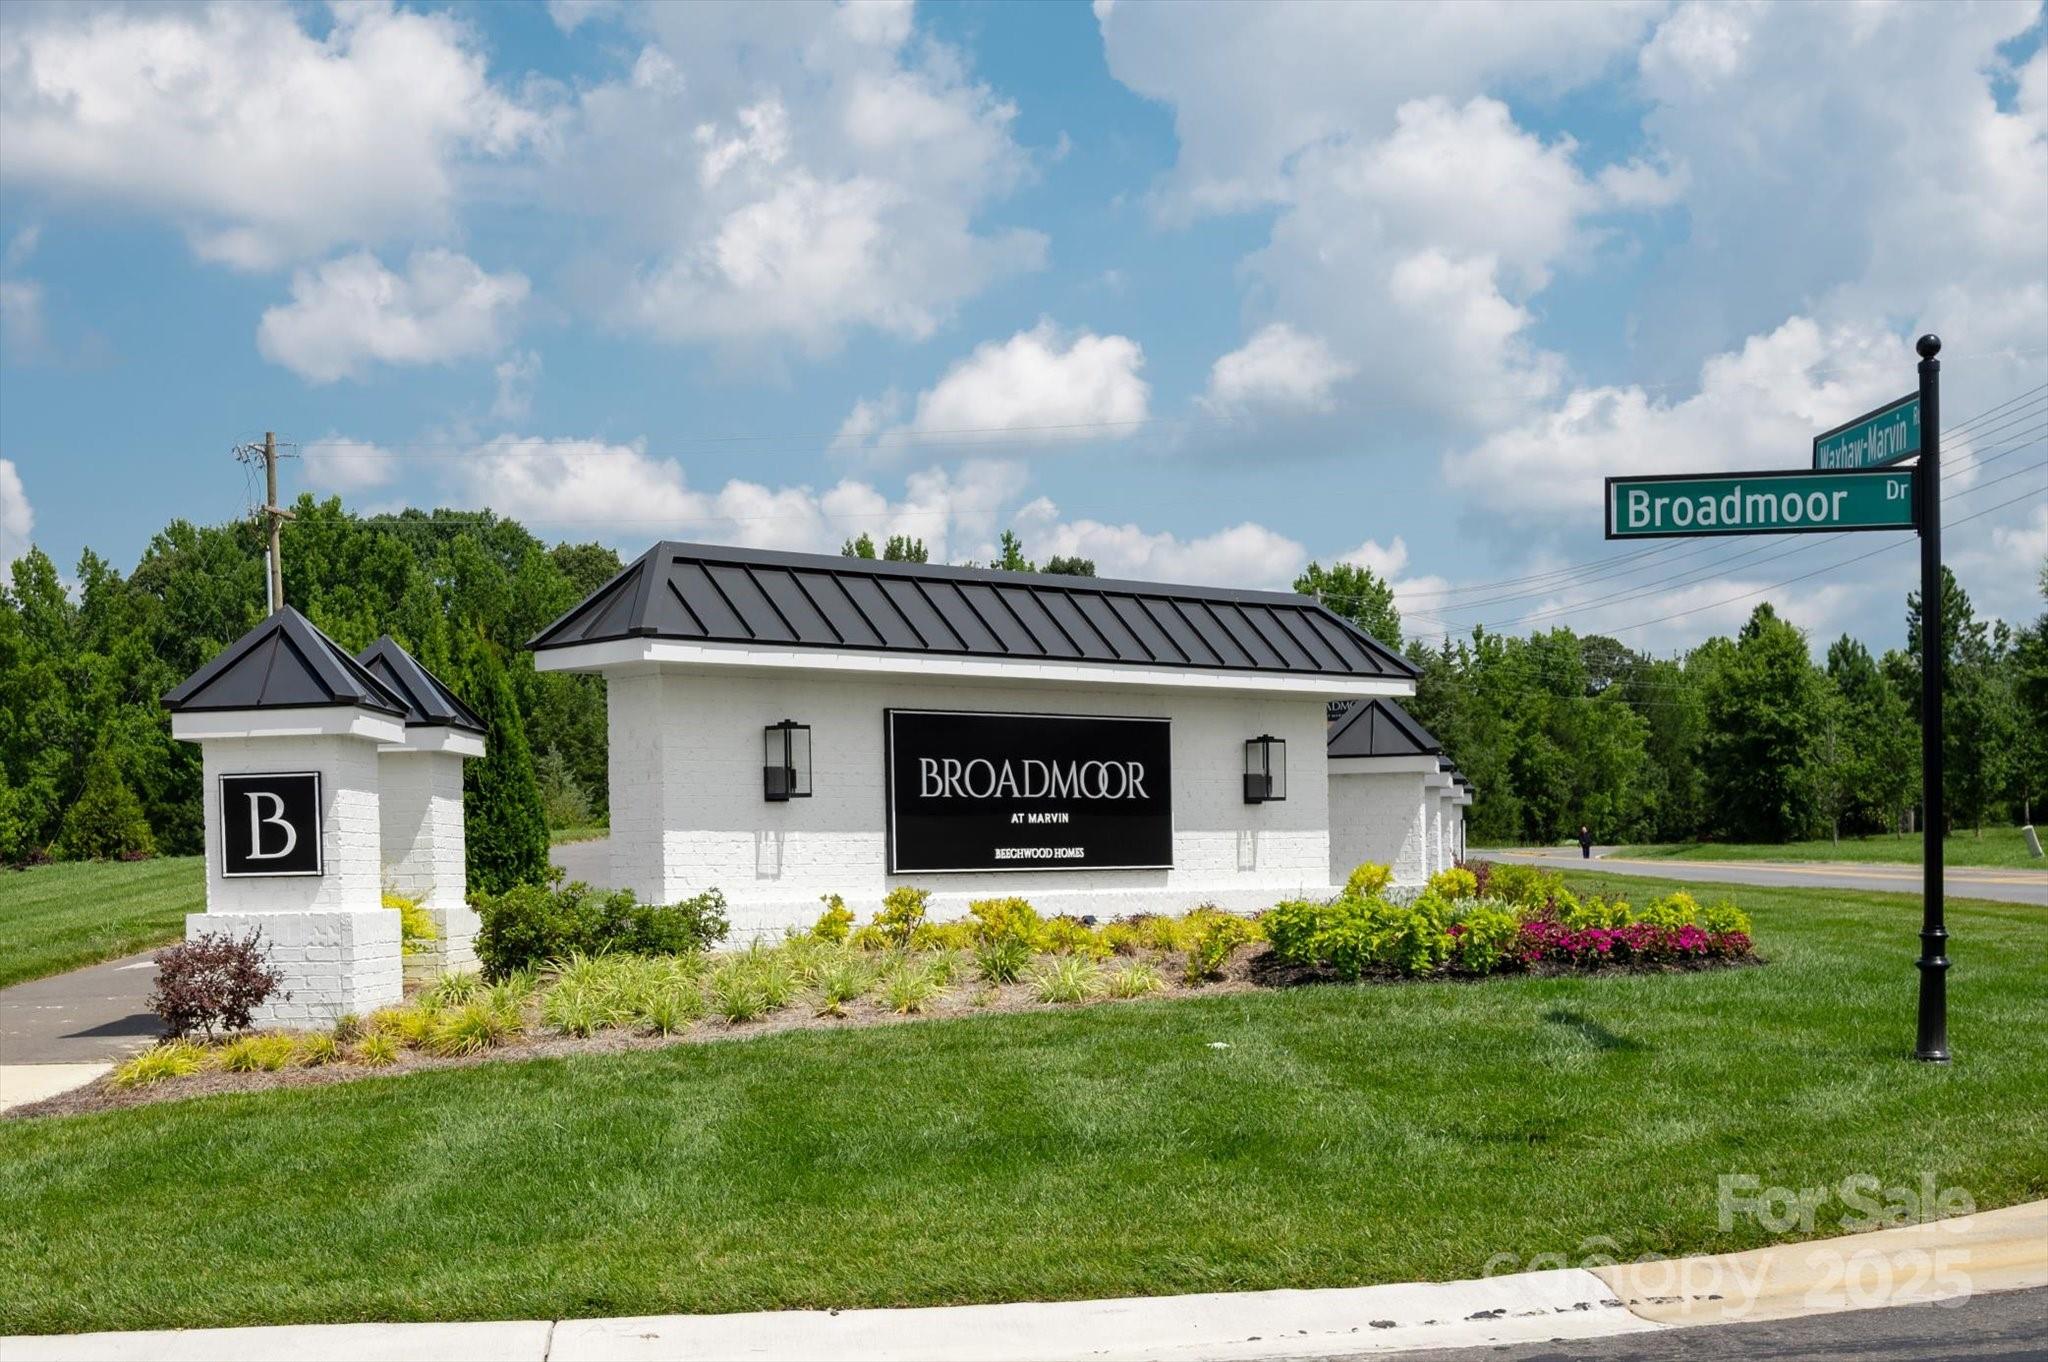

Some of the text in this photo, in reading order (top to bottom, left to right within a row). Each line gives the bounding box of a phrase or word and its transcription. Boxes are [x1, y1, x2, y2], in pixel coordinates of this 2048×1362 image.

[1820, 413, 1907, 469] Waxhaw-Marvin
[1628, 480, 1909, 528] Broadmoor Dr
[919, 757, 1150, 799] BROADMOOR
[243, 791, 297, 860] B
[1010, 813, 1069, 824] AT MARVIN
[994, 847, 1085, 859] BEECHWOOD HOMES
